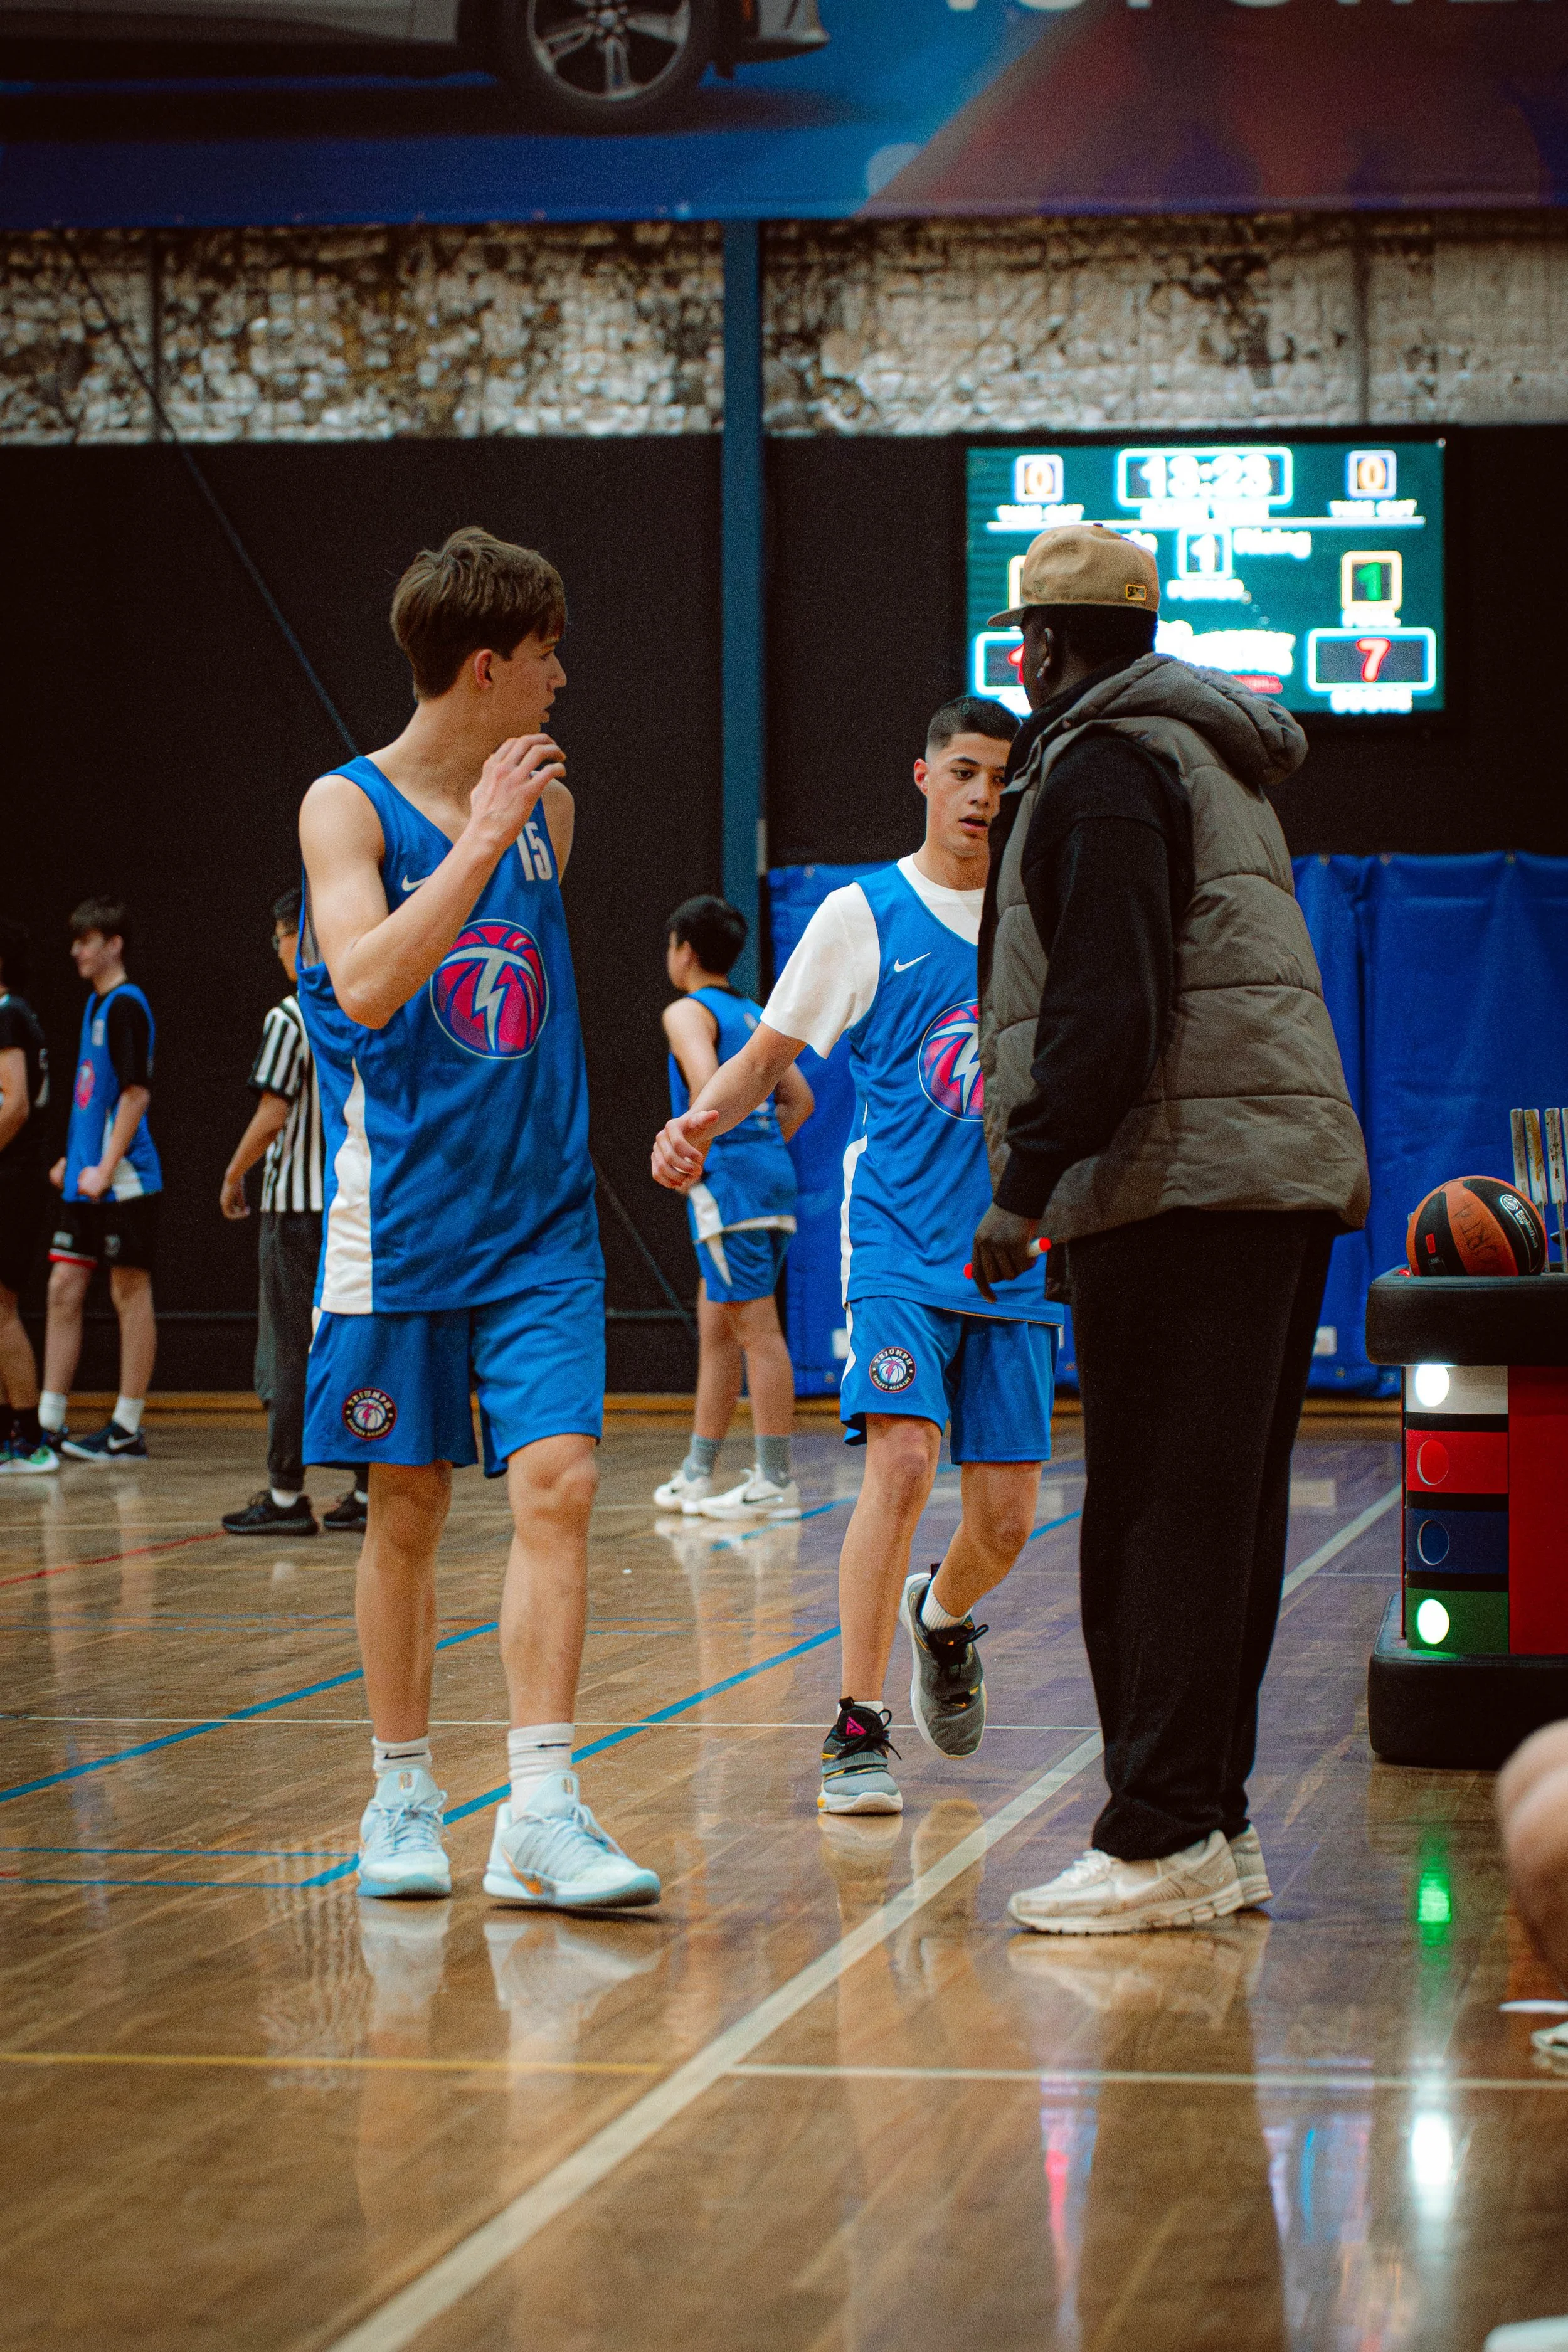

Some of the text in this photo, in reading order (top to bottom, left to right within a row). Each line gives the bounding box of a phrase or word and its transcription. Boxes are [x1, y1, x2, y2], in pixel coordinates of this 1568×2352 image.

[1025, 460, 1054, 495] 0
[1357, 456, 1387, 490] 0
[1190, 532, 1216, 572] 1
[1357, 562, 1382, 601] 1
[1355, 637, 1391, 683] 7
[515, 821, 553, 881] 15
[874, 1348, 913, 1365] TRIUMPH
[347, 1391, 392, 1409] TRIUMPH
